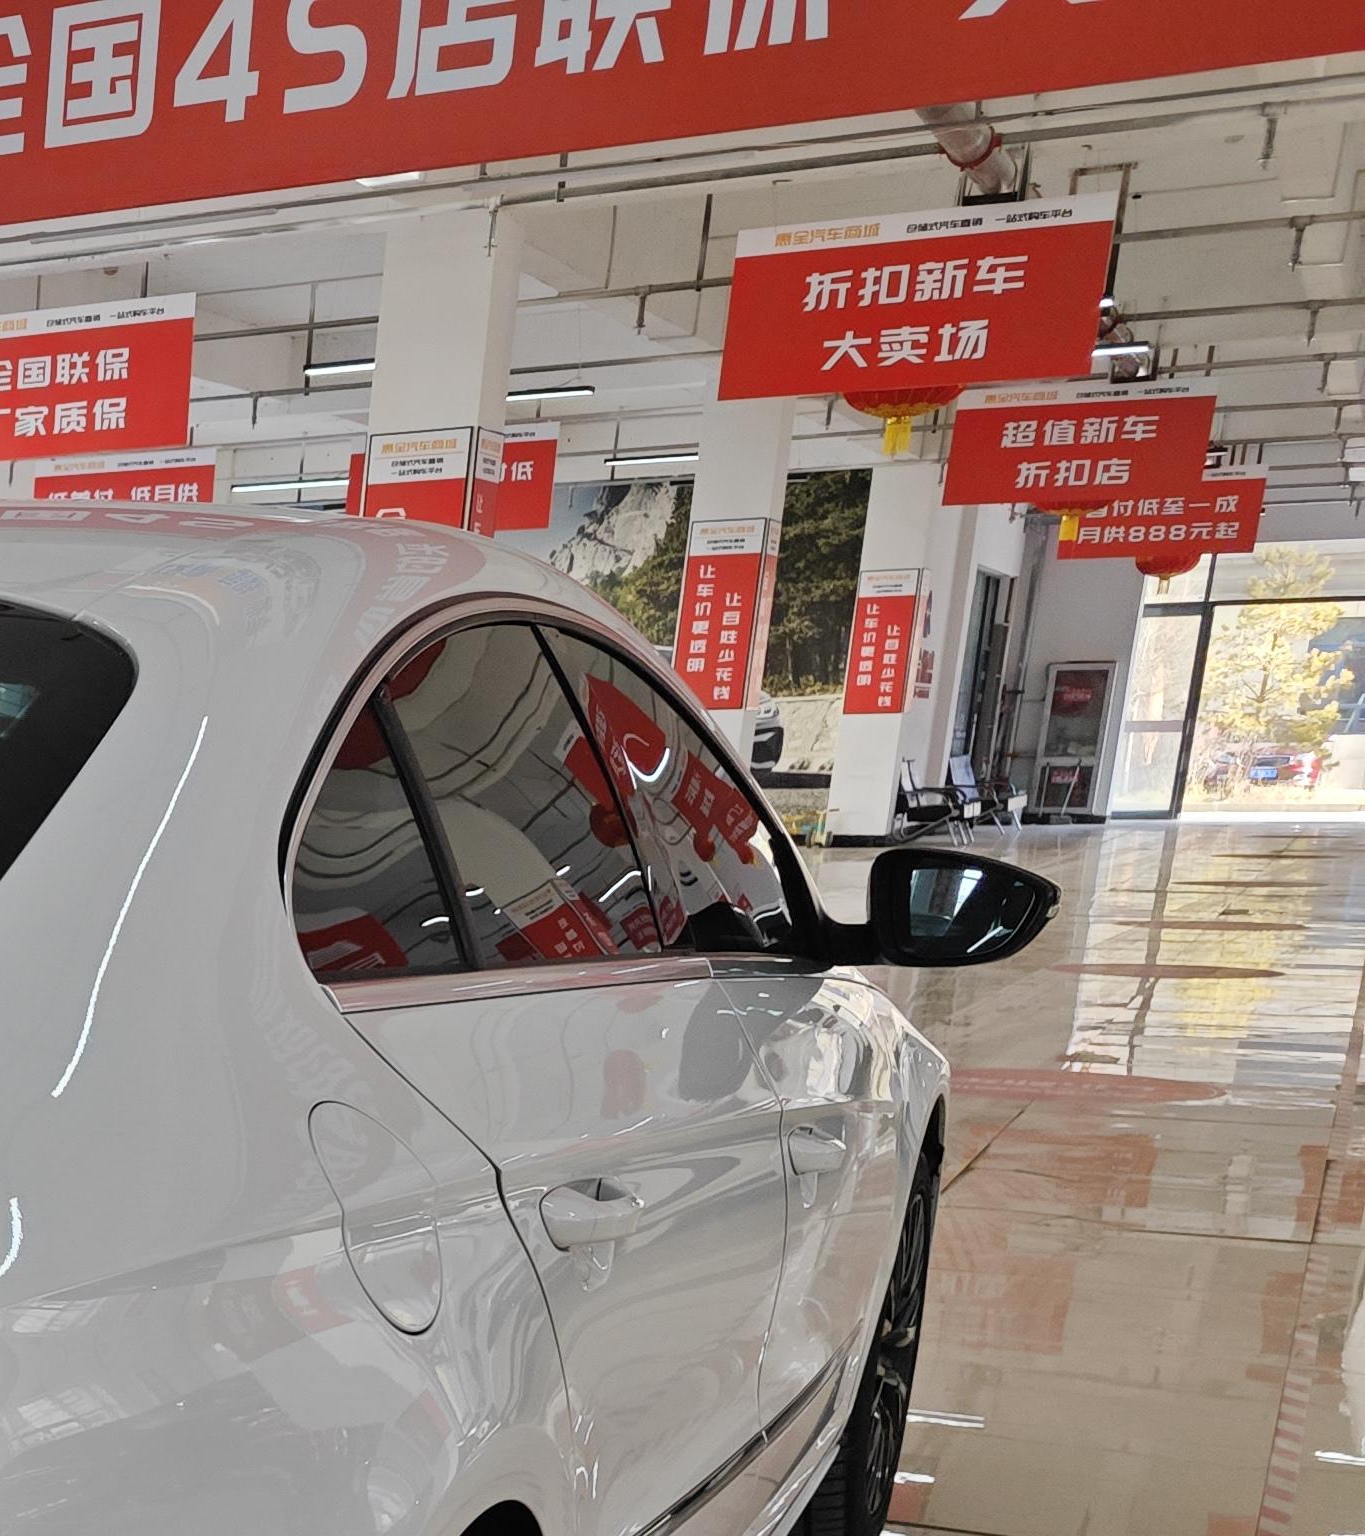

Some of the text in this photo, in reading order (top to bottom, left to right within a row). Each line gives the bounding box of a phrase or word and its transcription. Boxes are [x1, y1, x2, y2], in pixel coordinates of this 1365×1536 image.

[775, 222, 881, 248] 惠全汽车商城
[802, 255, 1029, 313] 折扣新车
[821, 319, 990, 371] 大卖场
[1000, 414, 1160, 449] 超值新车
[1014, 458, 1132, 489] 折扣店
[1077, 521, 1240, 545] 月供888元起
